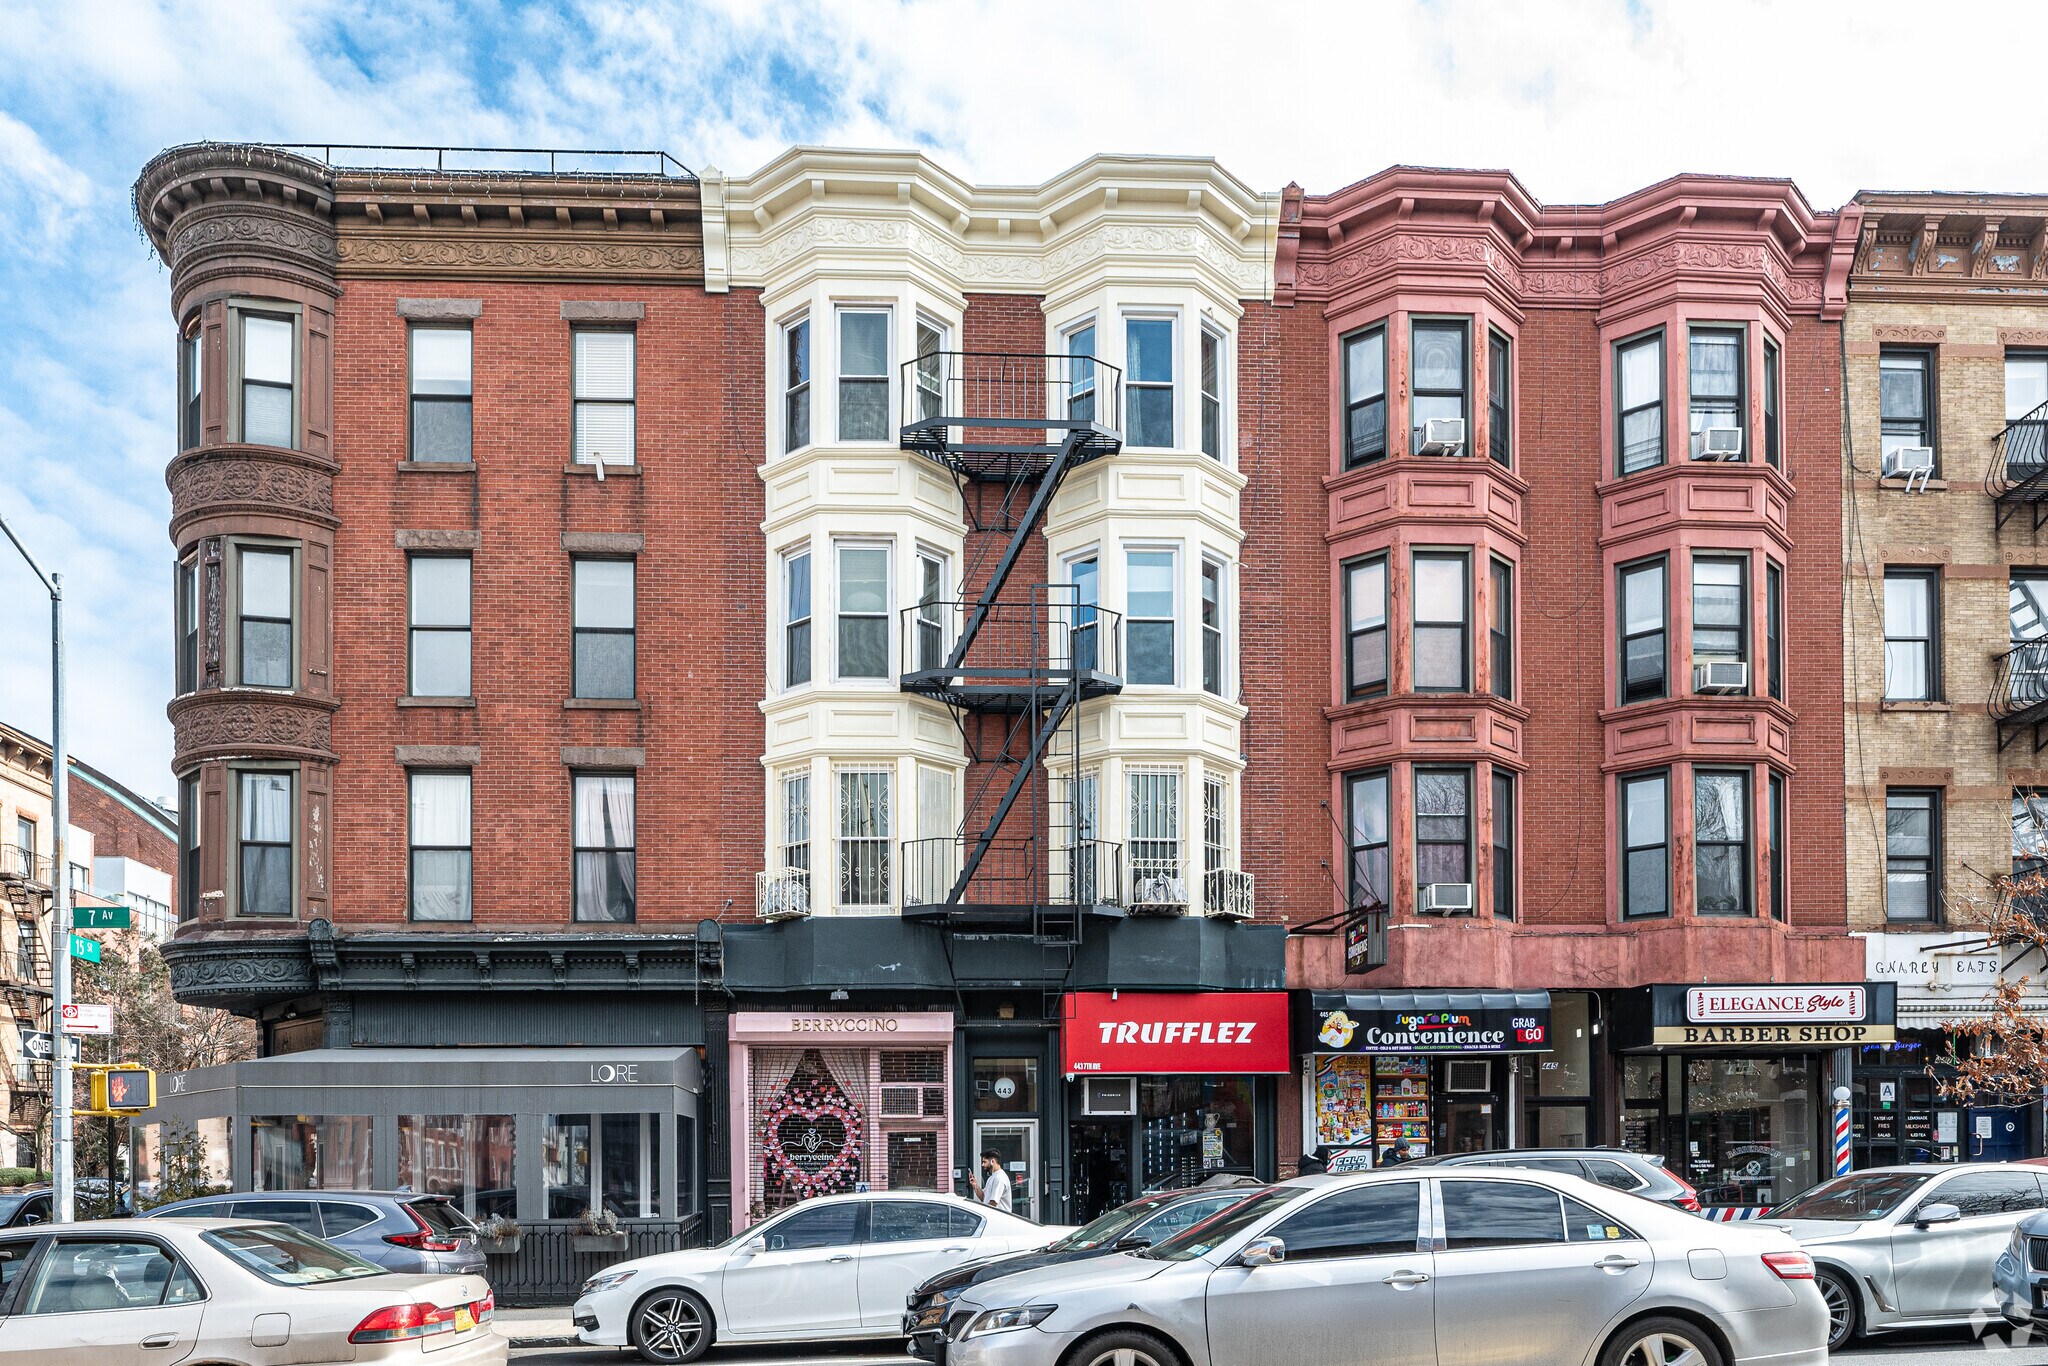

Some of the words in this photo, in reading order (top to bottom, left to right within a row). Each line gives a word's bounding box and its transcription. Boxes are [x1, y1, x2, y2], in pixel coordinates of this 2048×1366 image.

[88, 910, 96, 926] 7
[102, 910, 114, 920] Av
[76, 939, 84, 956] 15
[1876, 960, 1939, 974] GNARLY
[1956, 960, 1998, 973] EATS
[1710, 996, 1804, 1011] ELEGANCE
[1806, 994, 1845, 1012] Style
[792, 1019, 898, 1032] BERRYCCINO
[1396, 1014, 1429, 1032] Sugar
[1440, 1013, 1472, 1026] Plum
[1512, 1018, 1536, 1028] GRAB
[1098, 1021, 1257, 1044] TRUFFLEZ
[1366, 1026, 1505, 1044] Convenience
[1526, 1028, 1542, 1040] GO
[1684, 1028, 1792, 1042] BARBER
[1800, 1026, 1867, 1041] SHOP
[32, 1039, 49, 1052] ONE
[1894, 1041, 1921, 1052] Burger
[590, 1064, 638, 1082] LORE
[170, 1074, 186, 1093] LORE
[1883, 1085, 1892, 1096] A
[790, 1153, 834, 1162] berryccino
[1336, 1155, 1366, 1164] COLD
[1337, 1164, 1367, 1172] BEER
